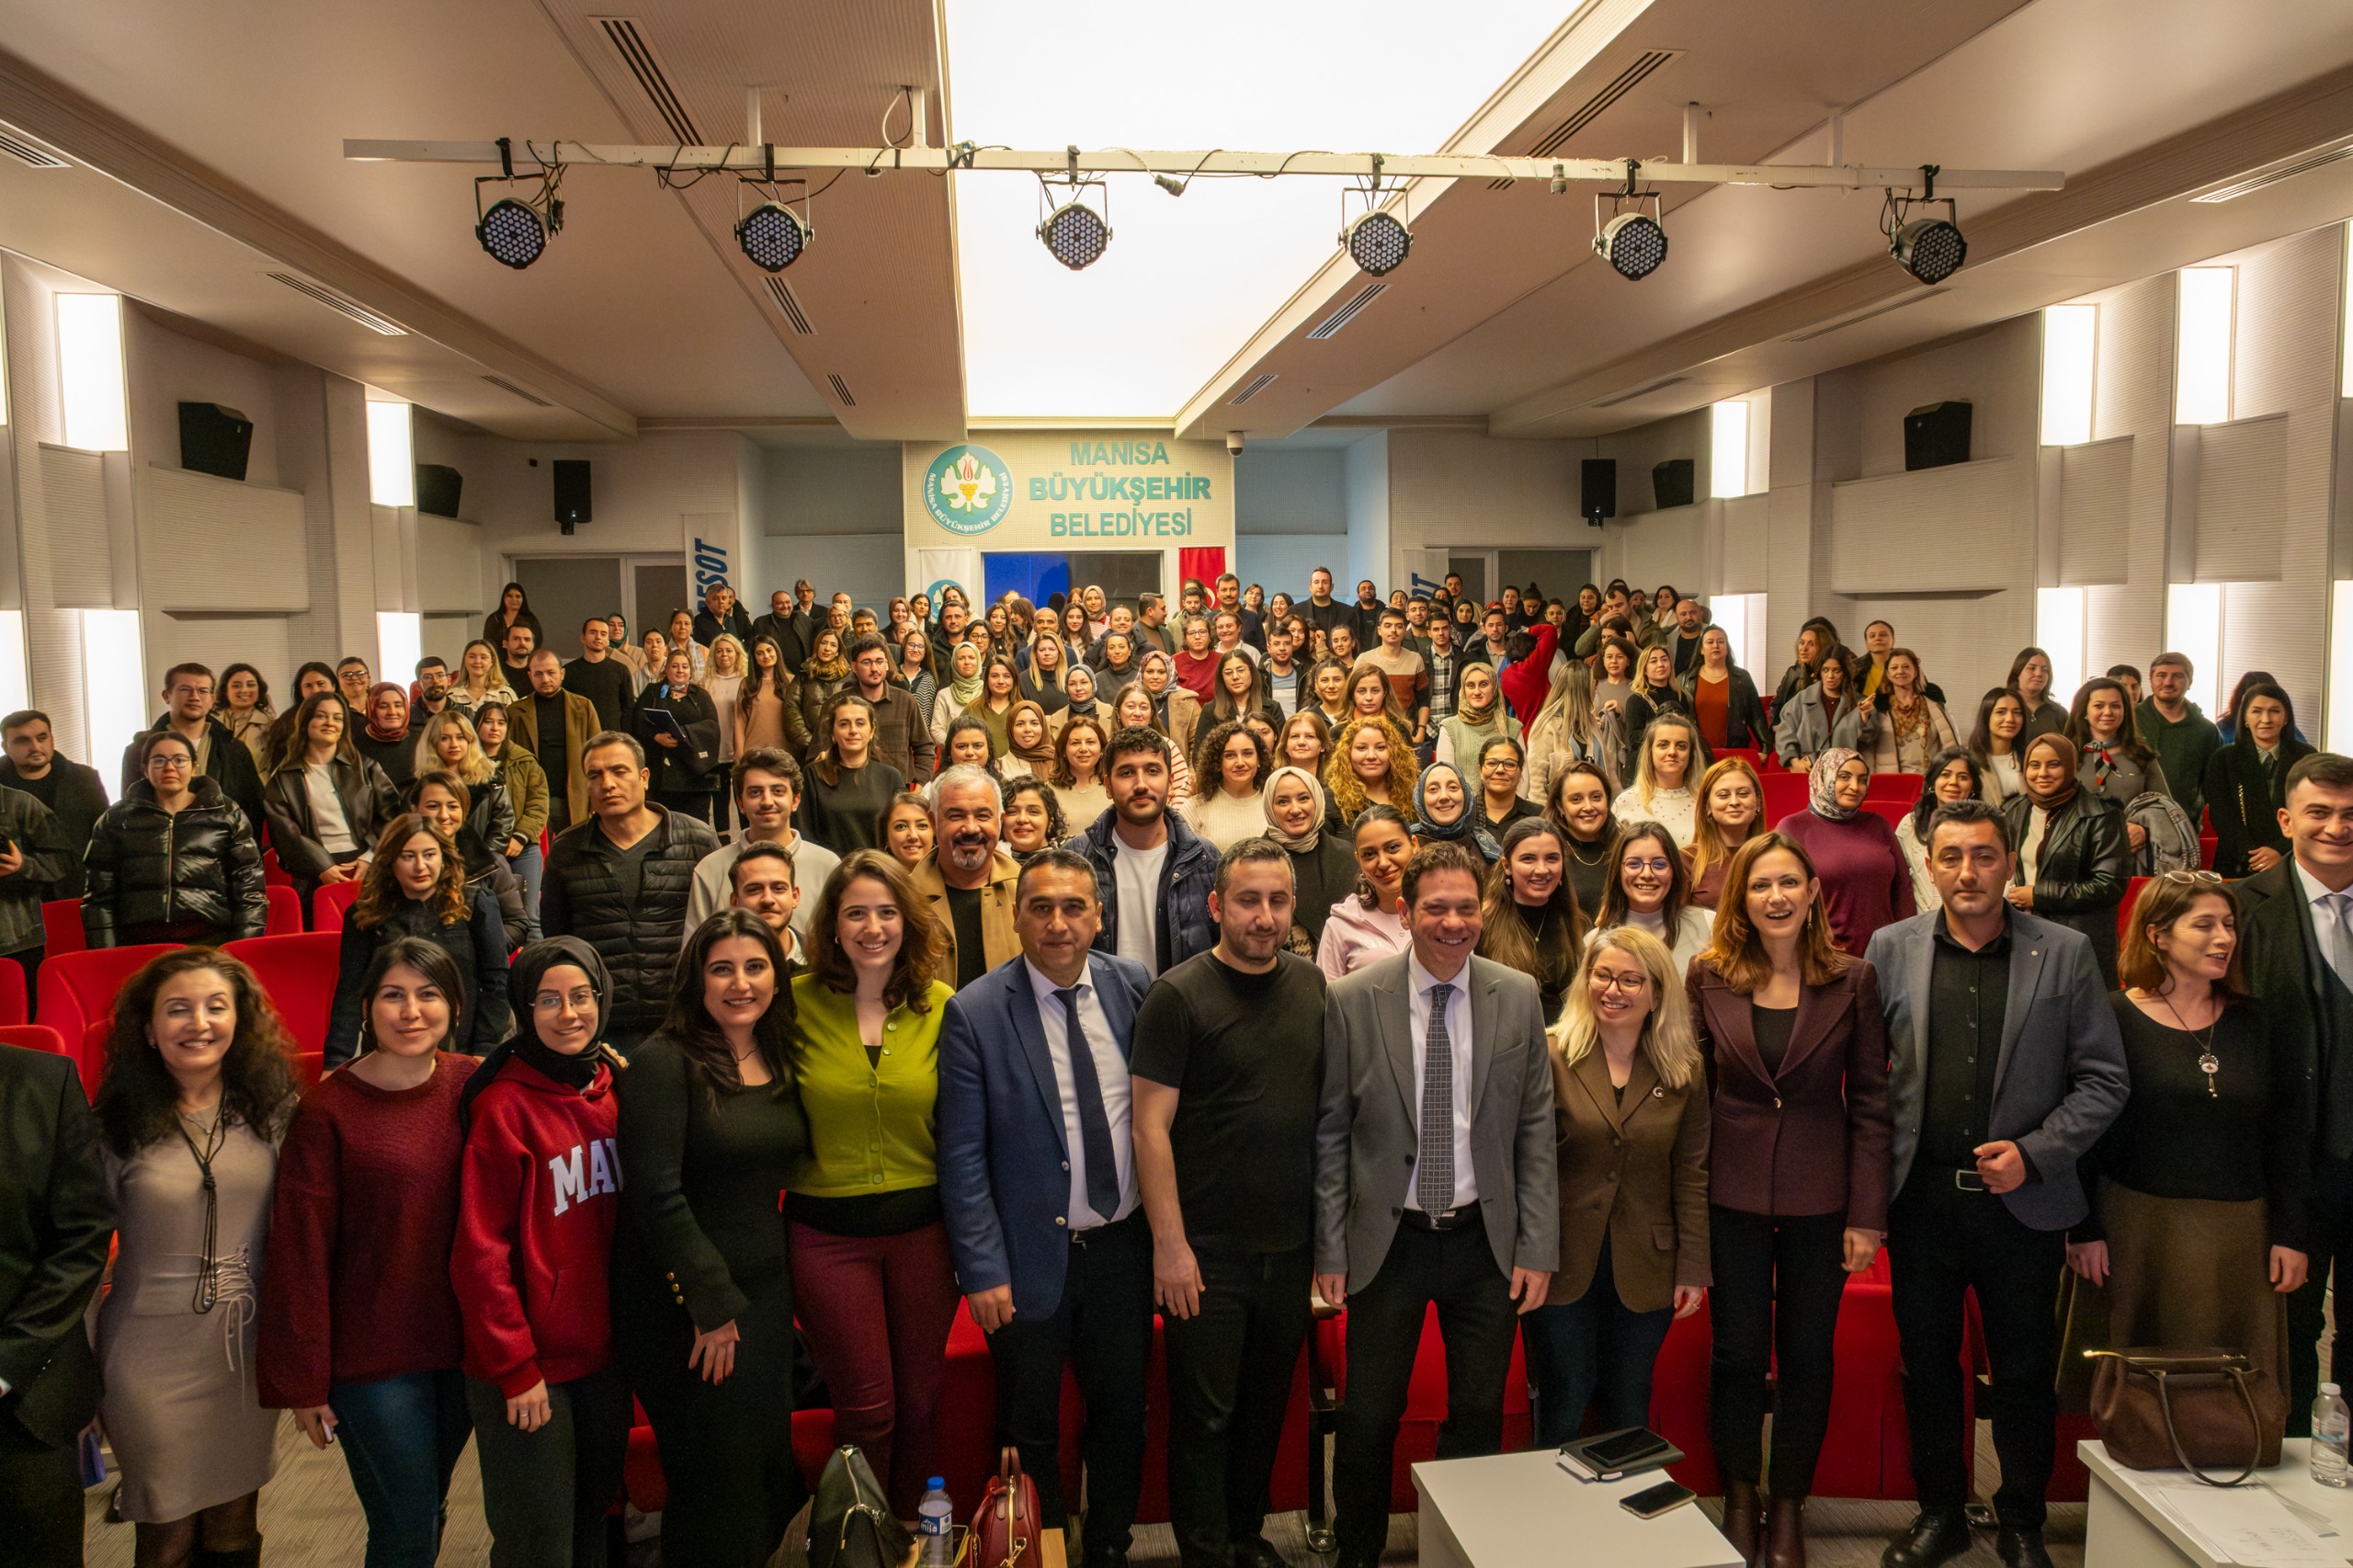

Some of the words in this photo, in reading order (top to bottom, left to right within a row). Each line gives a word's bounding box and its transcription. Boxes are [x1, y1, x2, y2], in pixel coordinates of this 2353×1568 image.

[1071, 438, 1170, 465] MANİSA
[1029, 472, 1211, 506] BÜYÜKŞEHİR
[935, 508, 991, 533] BÜYÜKŞEHİR
[1051, 507, 1192, 536] BELEDİYESİ
